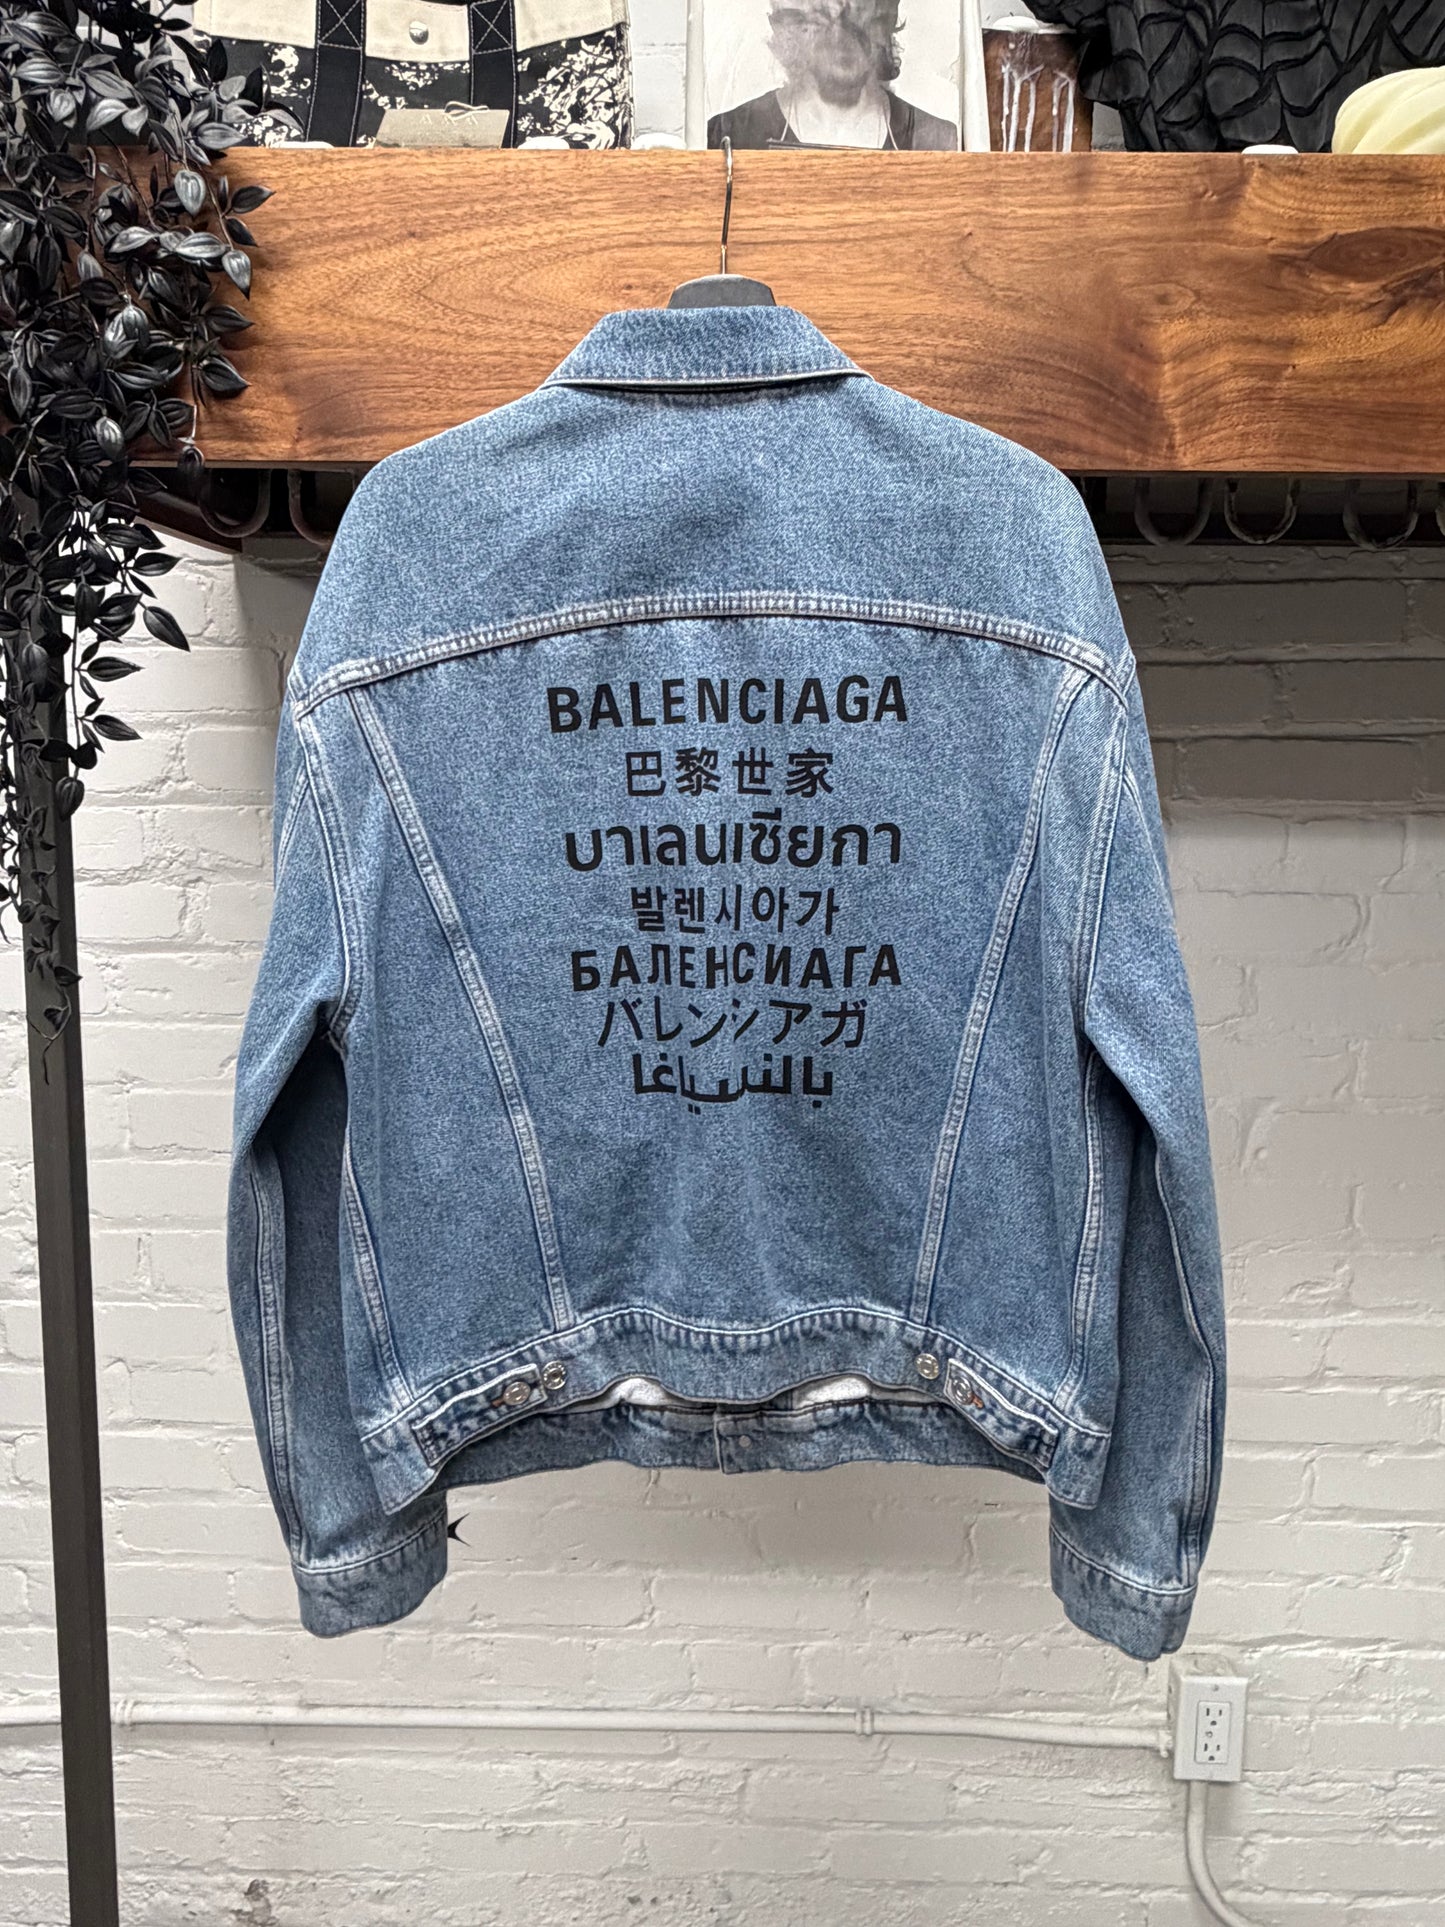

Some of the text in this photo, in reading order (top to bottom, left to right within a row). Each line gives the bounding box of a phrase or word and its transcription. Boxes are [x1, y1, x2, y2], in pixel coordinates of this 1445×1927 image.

[547, 675, 908, 733] BALENCIAGA
[626, 747, 833, 797] 巴黎世家
[631, 884, 839, 936] 발렌시아가
[571, 942, 902, 992] БАЛЕНСИАГА
[598, 996, 868, 1049] バレンシアガ
